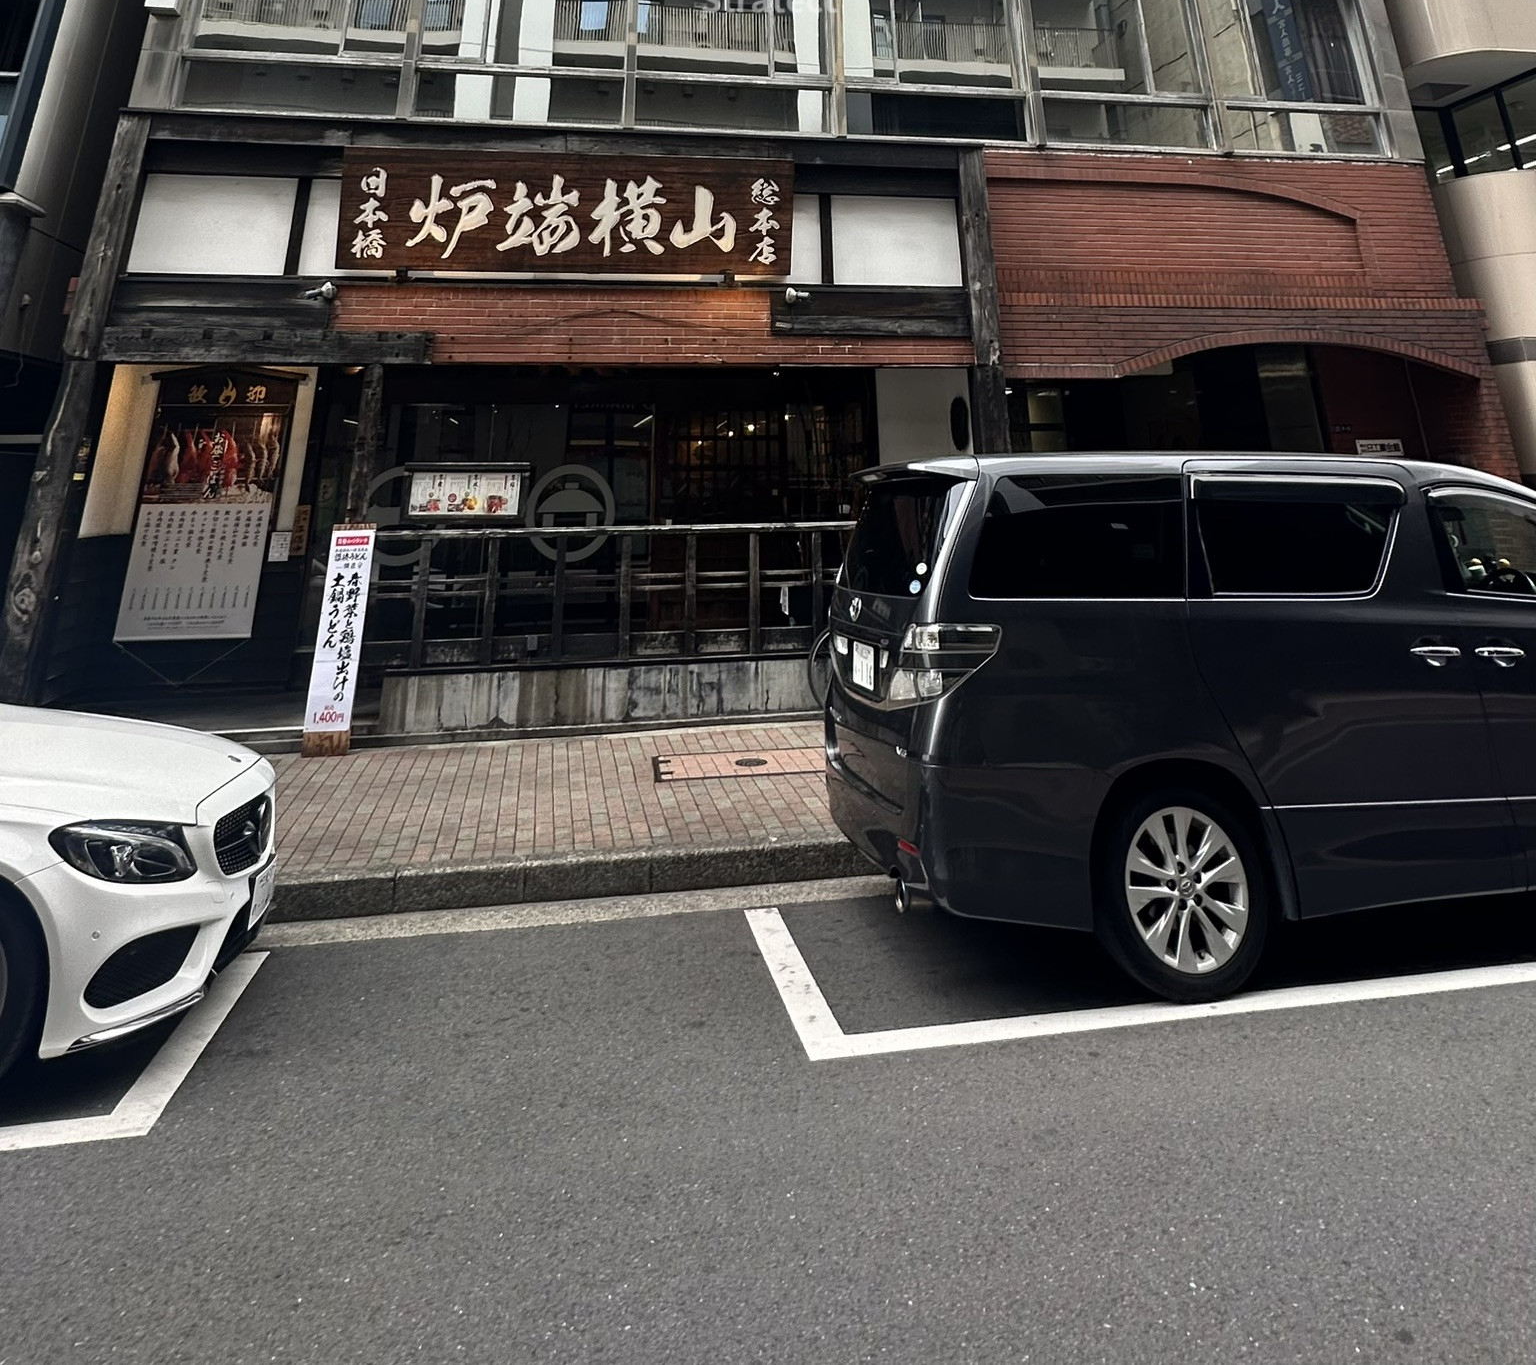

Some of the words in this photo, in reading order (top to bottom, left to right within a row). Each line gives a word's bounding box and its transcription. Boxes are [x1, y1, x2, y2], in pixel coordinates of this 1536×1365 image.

[350, 167, 389, 260] 日本橋
[405, 173, 738, 260] 炉端横山
[748, 177, 783, 265] 総本店
[322, 571, 346, 649] 土鍋うどん
[313, 711, 345, 724] 1,400円
